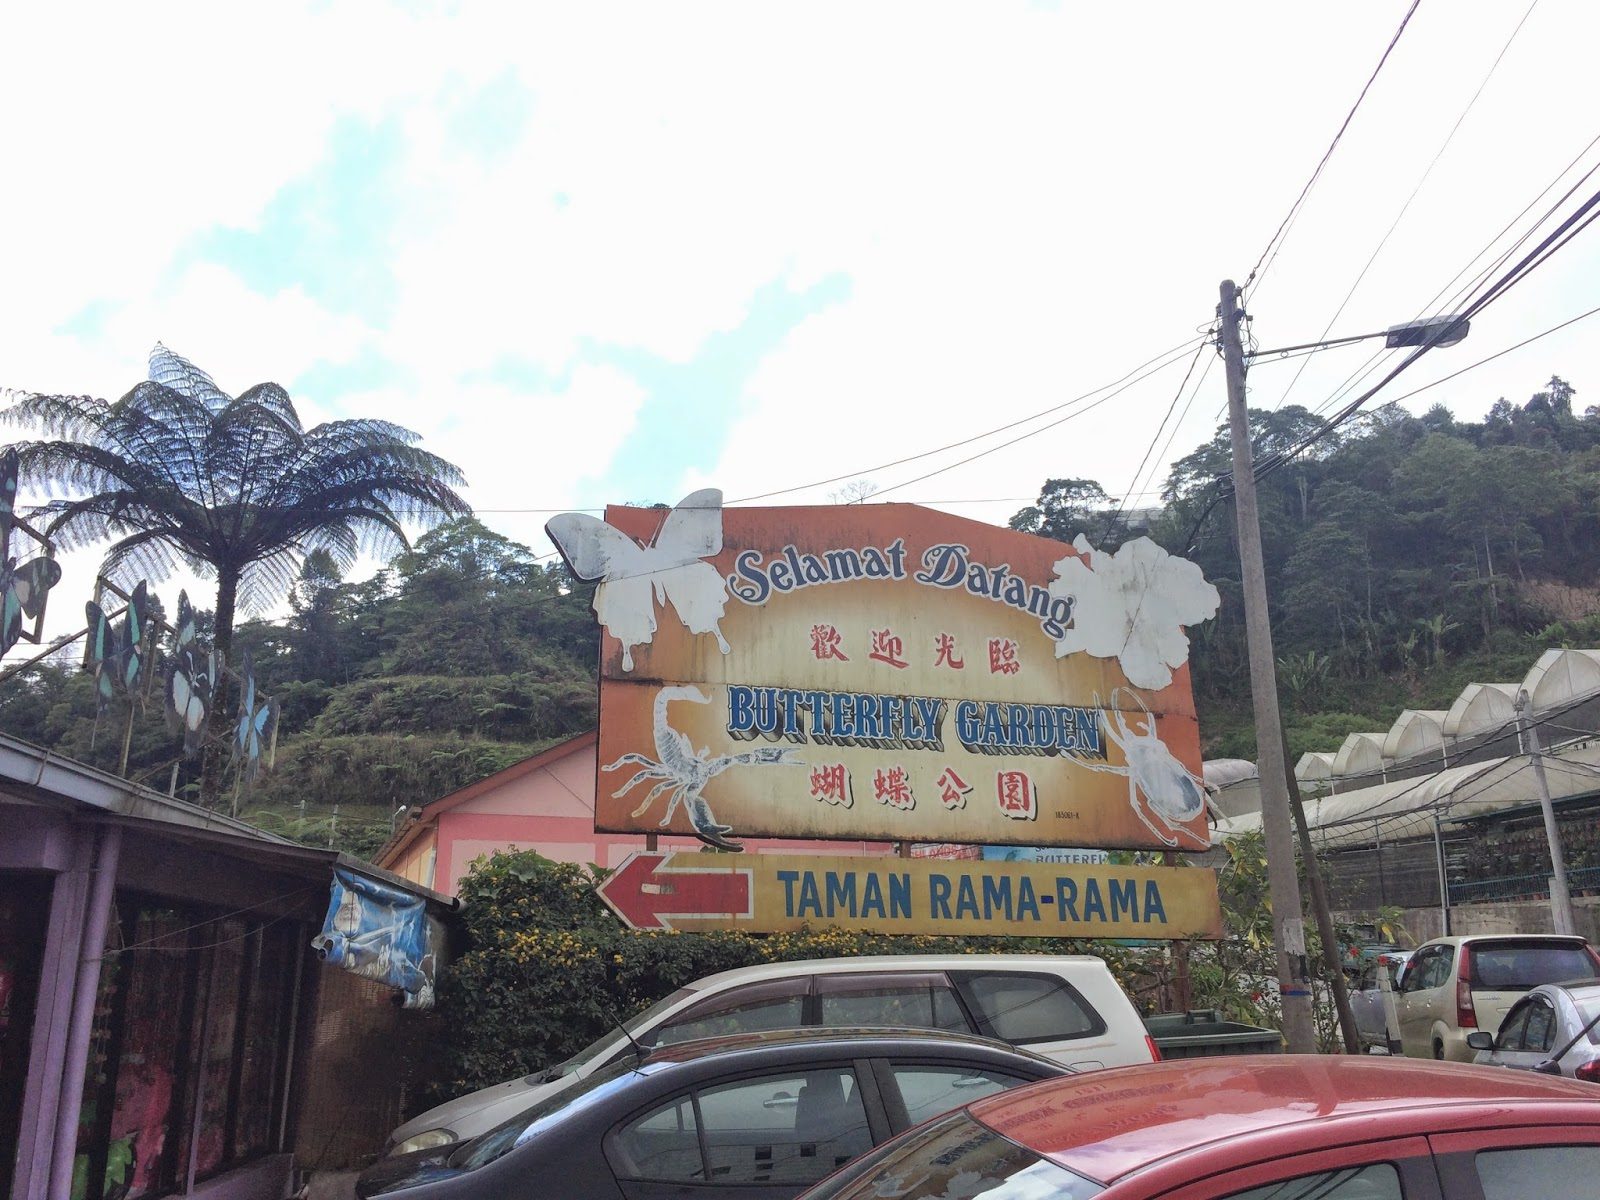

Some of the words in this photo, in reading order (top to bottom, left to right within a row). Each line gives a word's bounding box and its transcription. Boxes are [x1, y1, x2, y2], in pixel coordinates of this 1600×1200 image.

[729, 539, 905, 603] Selamat
[915, 544, 1073, 640] Datang
[810, 624, 1021, 675] 歡迎光臨
[727, 685, 947, 750] BUTTERFLY
[955, 699, 1105, 756] GARDEN
[810, 763, 1033, 816] 蝴蝶公園
[777, 870, 912, 919] TAMAN
[929, 874, 1168, 924] RAMA-RAMA
